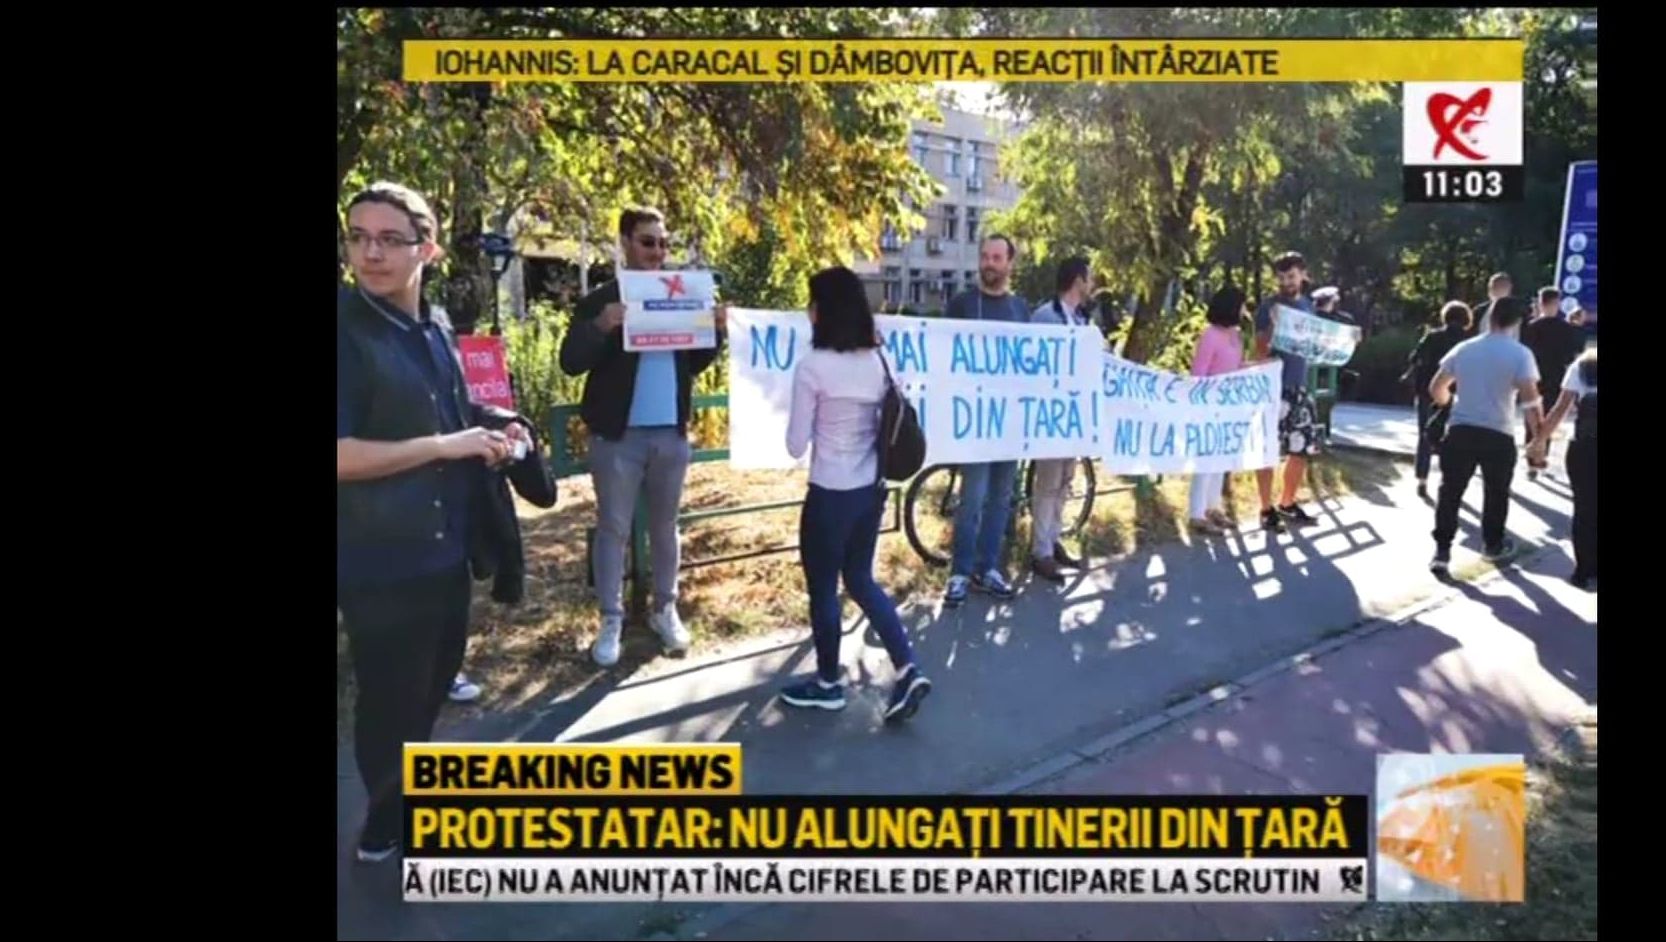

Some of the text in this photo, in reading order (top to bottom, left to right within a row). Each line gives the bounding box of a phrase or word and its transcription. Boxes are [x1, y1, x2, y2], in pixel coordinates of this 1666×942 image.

[750, 324, 797, 371] NU
[953, 385, 1007, 440] DIN
[1164, 376, 1184, 405] E
[1113, 416, 1142, 456] NU
[1150, 421, 1175, 457] LA
